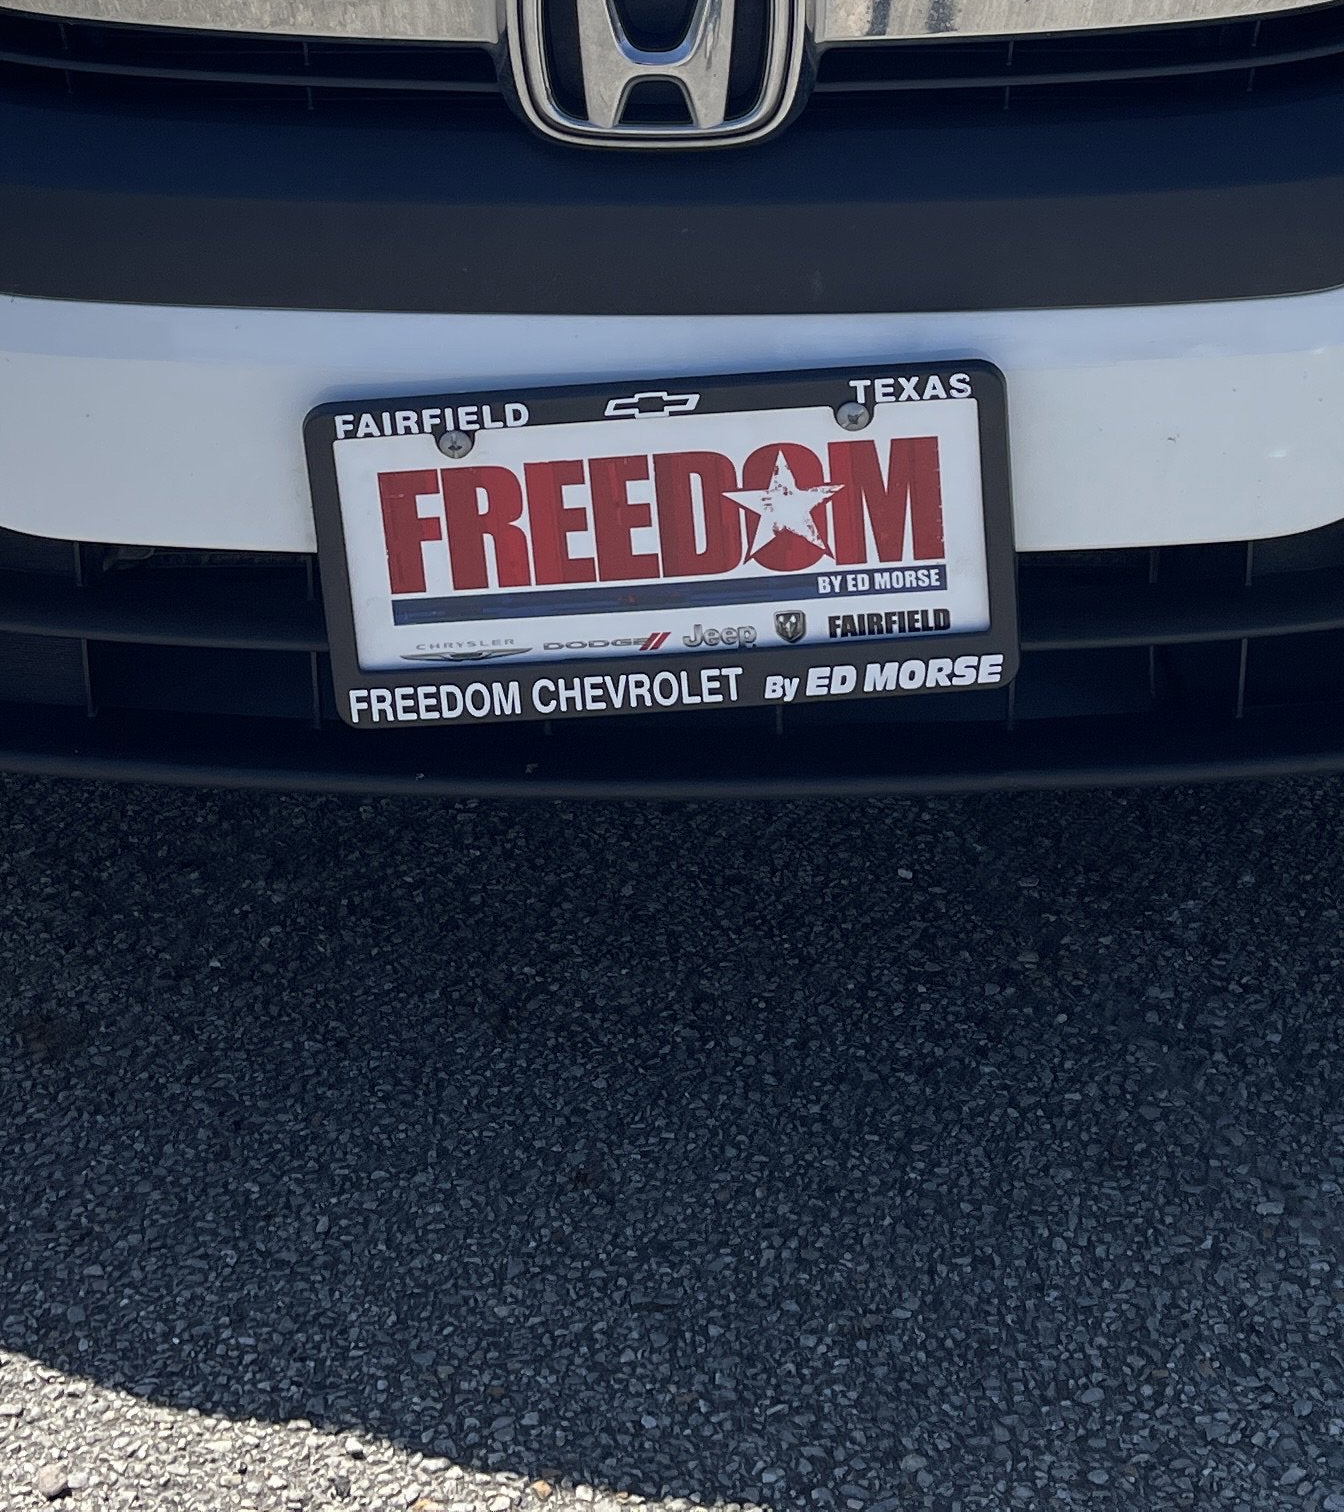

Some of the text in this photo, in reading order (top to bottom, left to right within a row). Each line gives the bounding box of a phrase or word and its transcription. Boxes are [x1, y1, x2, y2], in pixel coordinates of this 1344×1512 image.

[849, 373, 973, 404] TEXAS
[334, 402, 530, 439] FAIRFIELD
[377, 436, 946, 595] FREEDOM
[817, 568, 941, 594] BY ED MORSE
[682, 623, 757, 649] Jeep
[828, 608, 951, 639] FAIRFIELD
[415, 638, 515, 651] CHRYSLER
[348, 654, 1004, 723] FREEDOM CHEVROLET By ED MORSE
